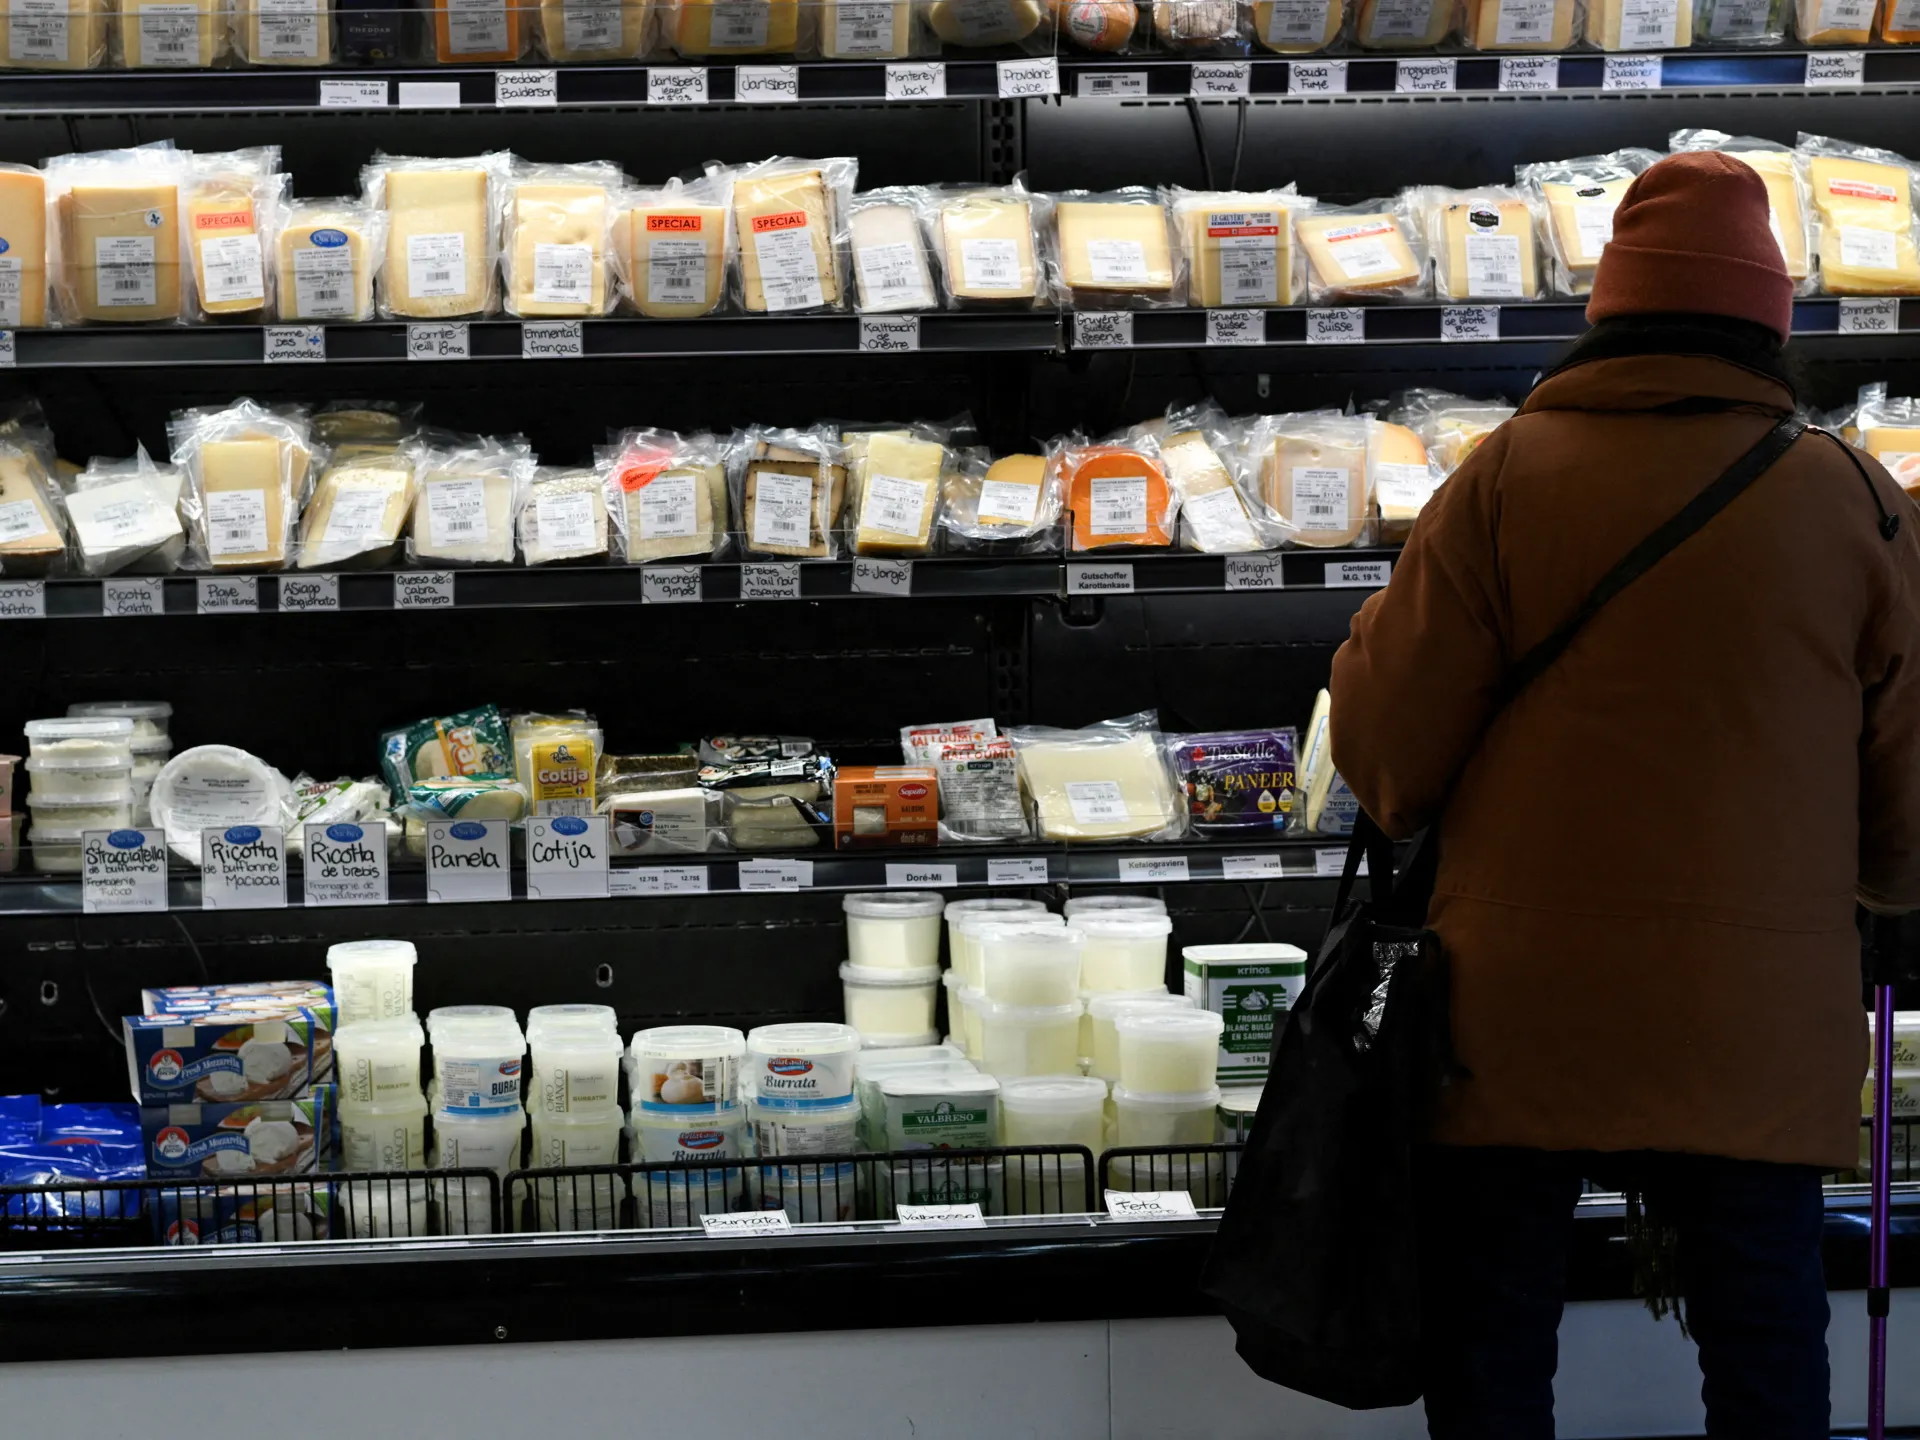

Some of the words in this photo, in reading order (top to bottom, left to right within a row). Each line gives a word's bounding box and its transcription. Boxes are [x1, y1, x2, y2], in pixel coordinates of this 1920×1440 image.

[1811, 55, 1845, 67] Double
[888, 71, 936, 84] Monterey
[1293, 66, 1328, 78] Gouda
[1809, 67, 1860, 78] Gloucester
[651, 75, 702, 92] Jarlsberg
[742, 76, 796, 94] Jarlsberg
[1011, 82, 1043, 93] dolce
[501, 87, 556, 99] Balderson
[900, 85, 928, 96] Jack
[201, 216, 247, 225] SPECIAL
[756, 216, 802, 229] SPECIAL
[1220, 213, 1245, 221] GRUYÈRE
[651, 219, 697, 229] SPECIAL
[1308, 310, 1348, 322] Gruyère
[1445, 318, 1457, 326] de
[1318, 320, 1354, 333] Suisse
[1852, 316, 1888, 330] Suisse
[265, 329, 304, 337] Tomme
[524, 327, 581, 339] Emmental
[877, 333, 890, 341] de
[530, 340, 580, 357] français
[743, 565, 779, 577] Brebis
[1342, 564, 1381, 572] Cantenaar
[397, 575, 429, 586] Queso
[431, 575, 444, 585] de
[645, 574, 701, 590] Manchego
[1081, 572, 1127, 580] Gutschoffer
[1342, 573, 1360, 581] M.G.
[1363, 573, 1372, 581] 19
[1373, 573, 1381, 581] %
[1078, 581, 1130, 590] Karottenkase
[108, 588, 151, 601] Ricotta
[402, 595, 412, 604] al
[414, 595, 449, 606] Romero
[941, 749, 1008, 761] HALLOUMI
[537, 766, 590, 785] Cotija
[1224, 772, 1295, 791] PANEER
[900, 787, 926, 797] Saputo
[86, 845, 165, 863] Stracciatella
[211, 841, 278, 863] Ricotta
[311, 842, 375, 864] Ricotta
[431, 845, 500, 869] Panela
[532, 840, 596, 868] Cotija
[88, 866, 100, 875] de
[203, 864, 217, 874] de
[321, 866, 338, 877] de
[341, 864, 380, 878] brebis
[1128, 860, 1184, 870] Kefalograviera
[906, 873, 942, 882] Doré-Mi
[1148, 869, 1167, 877] Grec
[1237, 966, 1271, 975] krinos
[1237, 1014, 1272, 1023] FROMAGE
[1225, 1024, 1250, 1032] BLANC
[1231, 1033, 1241, 1041] EN
[1242, 1032, 1273, 1041] SAUMUR
[181, 1062, 201, 1079] Fresh
[202, 1055, 240, 1073] Mozzarella
[357, 1058, 369, 1102] BIANCO
[764, 1075, 817, 1089] Burrata
[350, 1074, 359, 1101] ORO
[554, 1068, 565, 1113] BIANCO
[545, 1084, 554, 1112] ORO
[917, 1112, 974, 1124] VALBRESO
[187, 1140, 208, 1157] Fresh
[208, 1134, 247, 1151] Mozzarella
[672, 1149, 727, 1162] Burrata
[1115, 1201, 1161, 1211] Feta
[705, 1215, 781, 1229] Burrata
